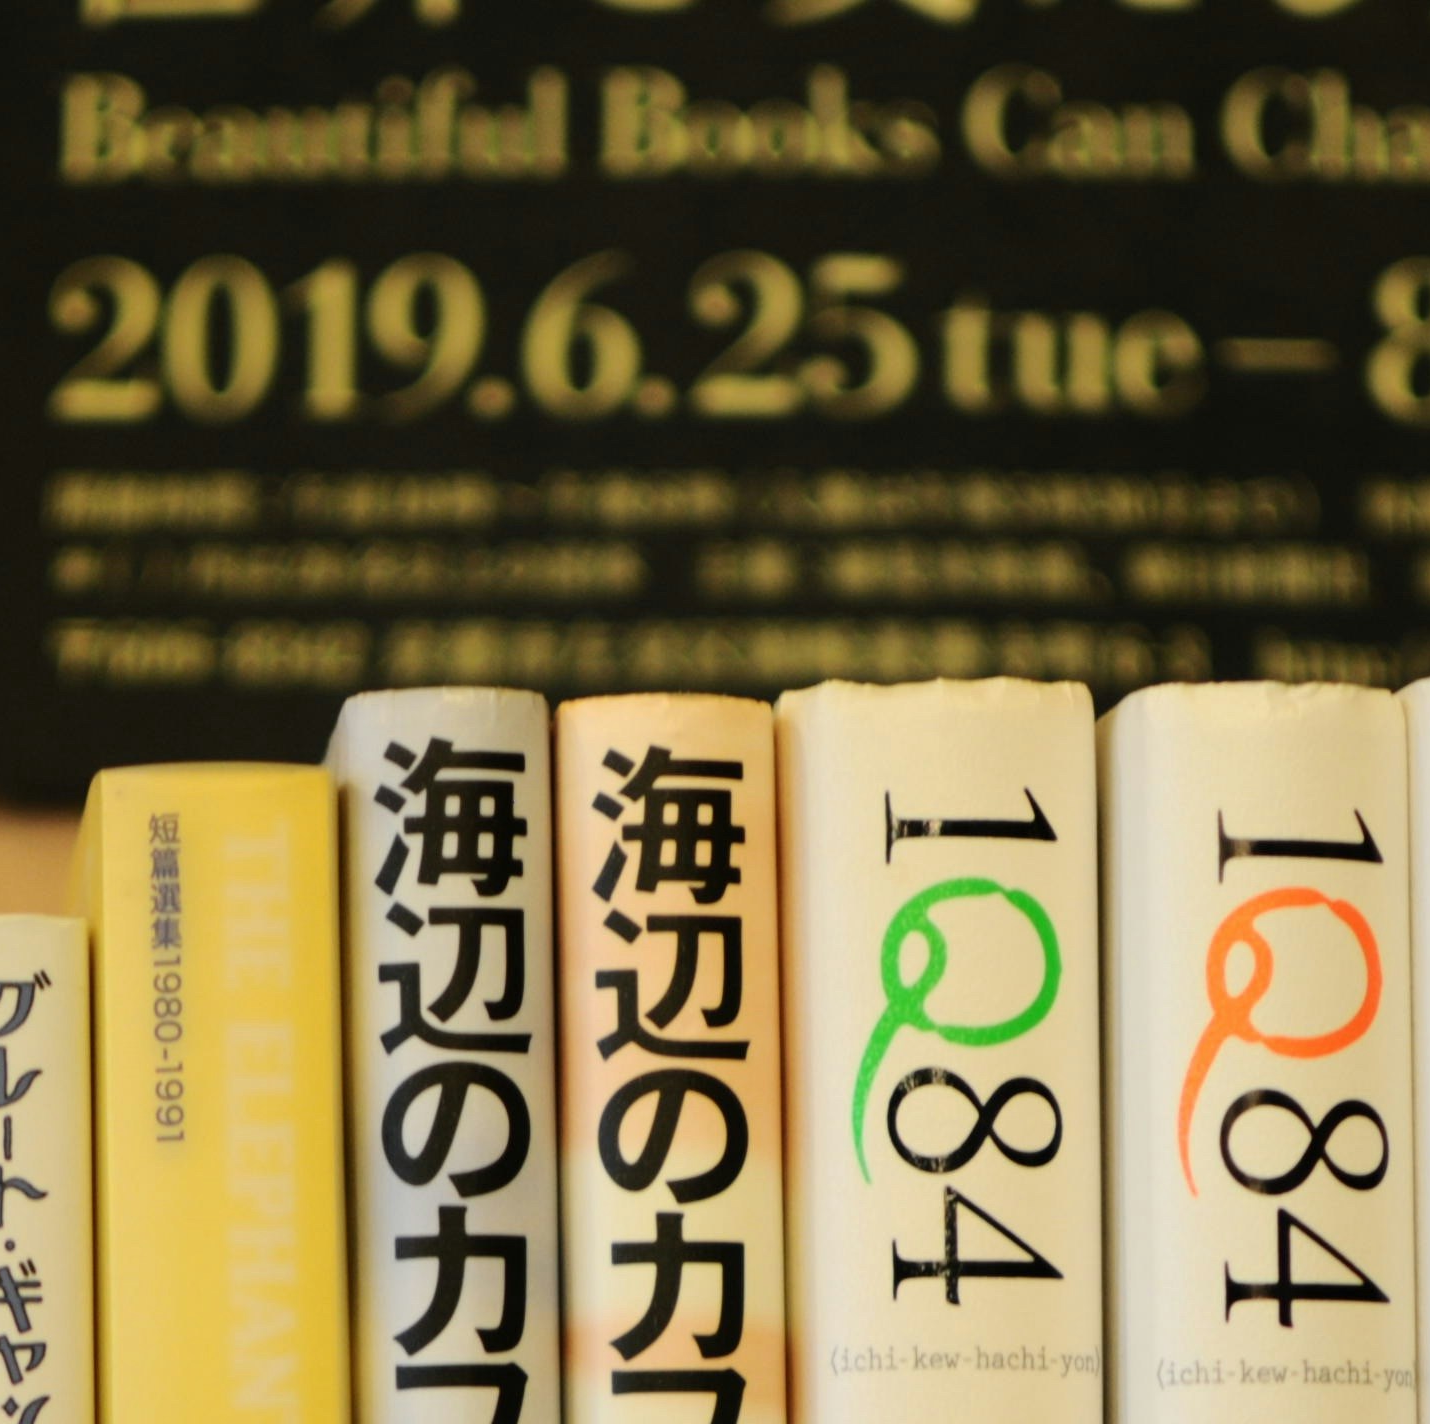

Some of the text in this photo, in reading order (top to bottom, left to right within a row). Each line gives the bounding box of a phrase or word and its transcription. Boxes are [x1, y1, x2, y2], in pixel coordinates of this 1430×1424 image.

[59, 66, 568, 185] Beautiful
[601, 66, 942, 184] Books
[963, 64, 1195, 183] Can
[852, 787, 1064, 1306] 1Q84
[1177, 808, 1391, 1329] 1Q84
